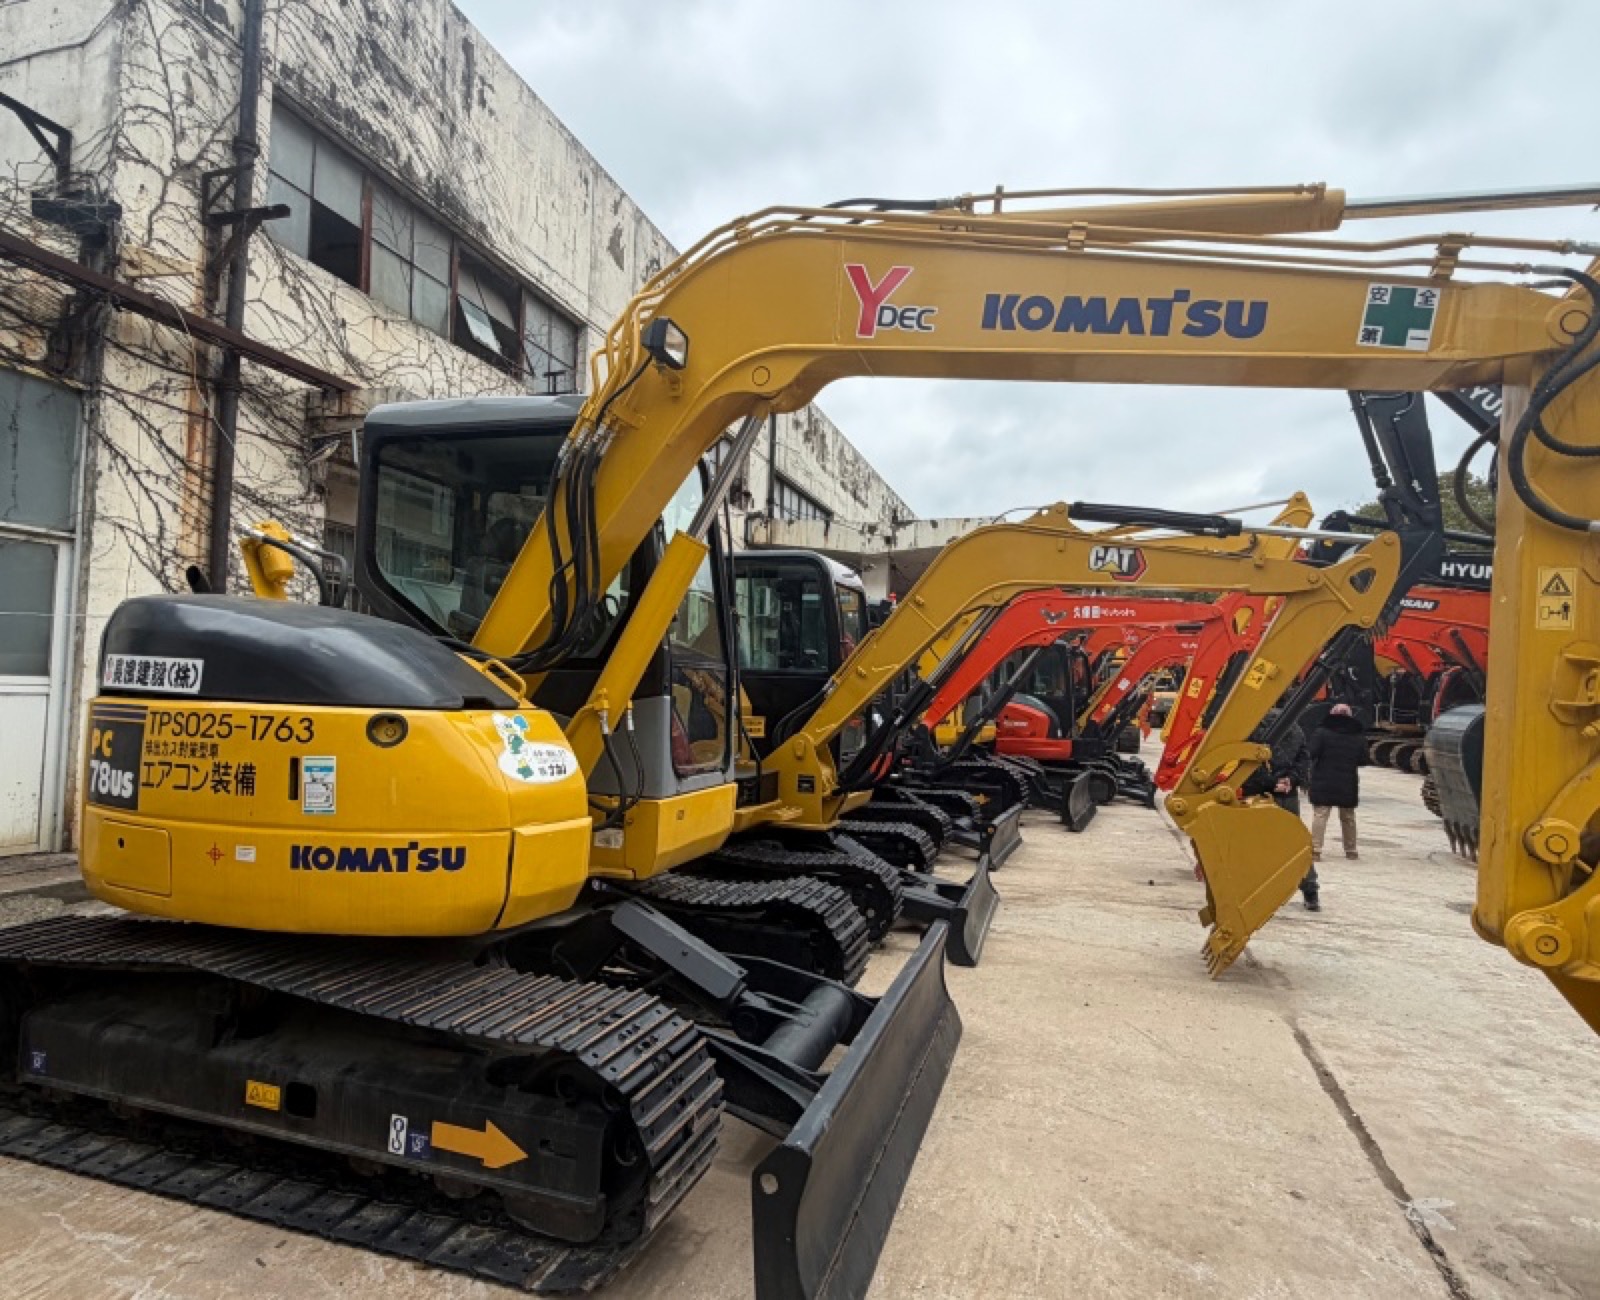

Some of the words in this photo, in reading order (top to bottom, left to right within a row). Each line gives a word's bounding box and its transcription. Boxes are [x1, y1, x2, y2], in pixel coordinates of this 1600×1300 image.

[981, 289, 1269, 339] KOMATSU
[1088, 546, 1135, 573] CAT
[91, 728, 113, 757] PC
[150, 711, 315, 743] TPS025-1763
[141, 761, 257, 797] エアコン装備
[290, 841, 467, 873] KOMATSU
